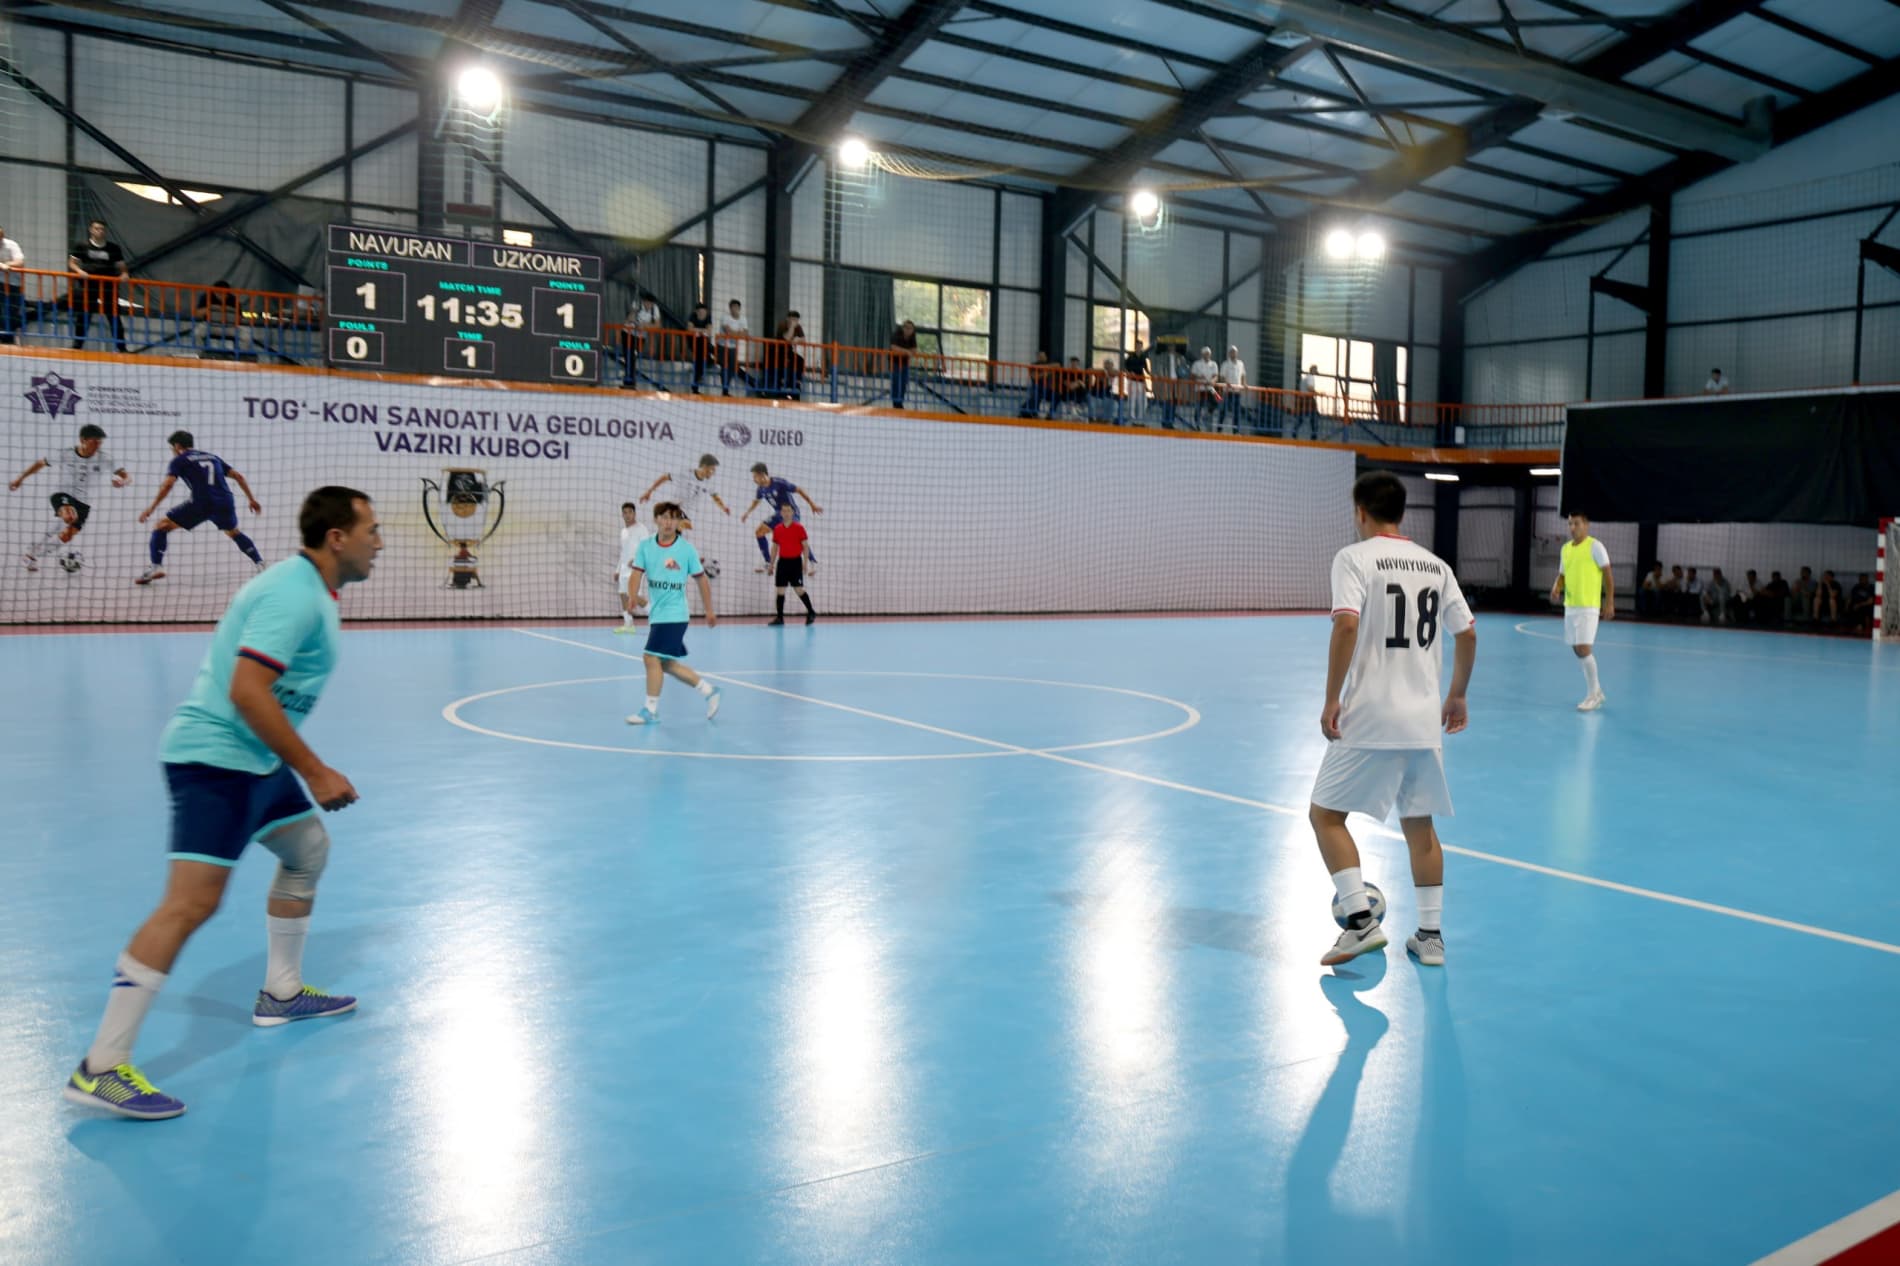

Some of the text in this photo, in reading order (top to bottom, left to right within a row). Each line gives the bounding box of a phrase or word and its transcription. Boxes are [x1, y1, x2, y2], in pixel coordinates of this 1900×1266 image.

[349, 231, 452, 261] NAVURAN
[347, 258, 389, 270] POINTS
[493, 248, 582, 276] UZKOMIR
[356, 282, 376, 310] 1
[439, 281, 502, 296] MATCH TIME
[549, 280, 585, 292] POINTS
[417, 295, 524, 329] 11:35
[556, 303, 575, 329] 1
[338, 320, 376, 333] FOULS
[457, 331, 483, 342] TIME
[346, 336, 368, 359] 0
[558, 340, 591, 351] FOULS
[460, 346, 477, 368] 1
[564, 355, 584, 376] 0
[387, 406, 499, 431] SANOATI
[507, 413, 539, 433] VA
[547, 415, 675, 441] GEOLOGIYA
[375, 431, 570, 460] VAZIRI KUBOGI
[760, 428, 804, 447] UZGEO
[198, 460, 215, 485] 7
[1375, 557, 1441, 575] NAVOIYURAN
[1386, 583, 1439, 651] 18
